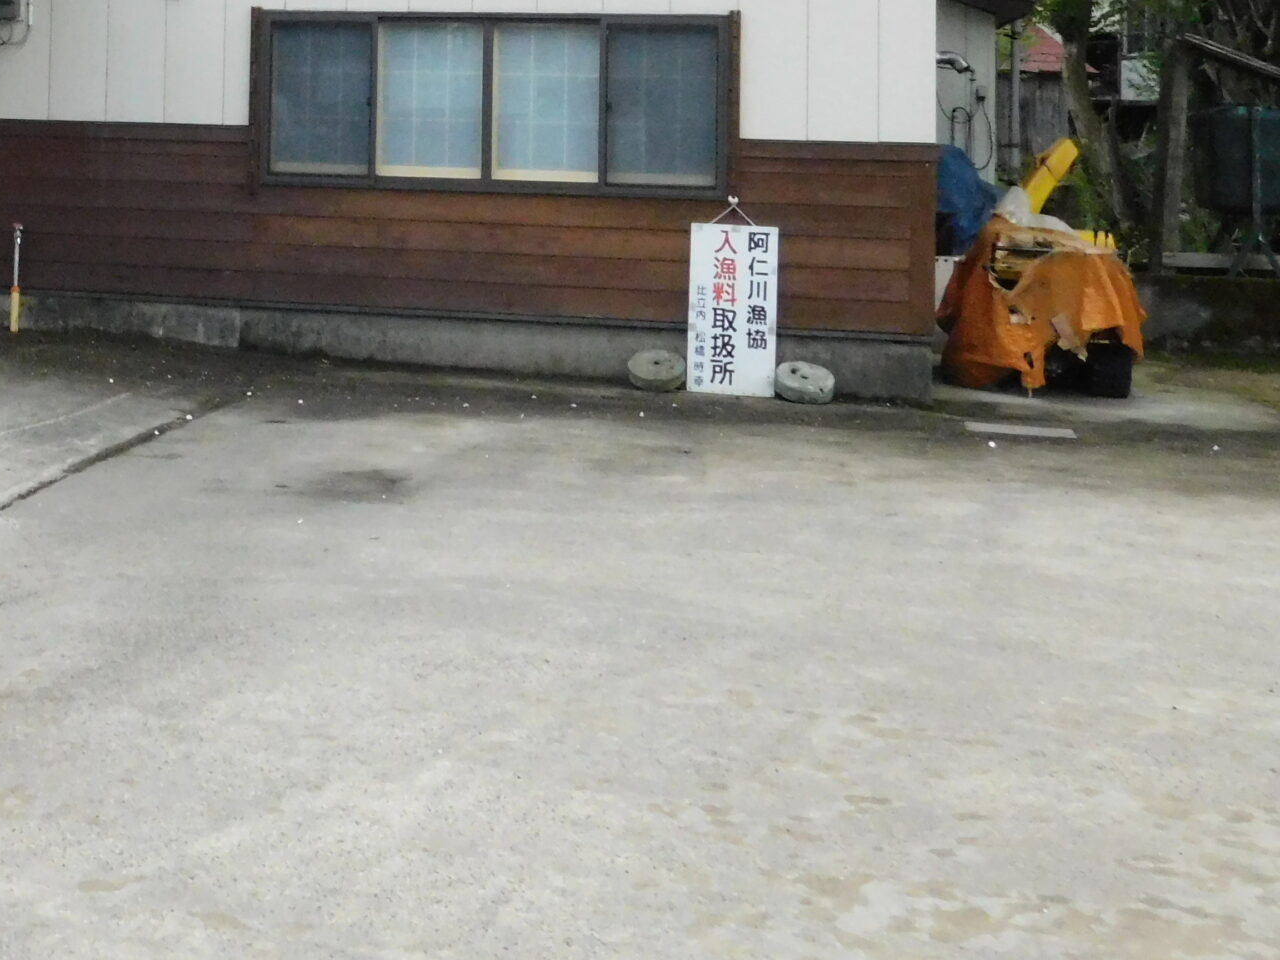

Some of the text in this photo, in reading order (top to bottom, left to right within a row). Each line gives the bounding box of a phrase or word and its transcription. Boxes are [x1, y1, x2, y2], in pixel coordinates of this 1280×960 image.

[710, 230, 738, 386] 入漁料取扱所
[746, 231, 771, 350] 阿仁川漁協
